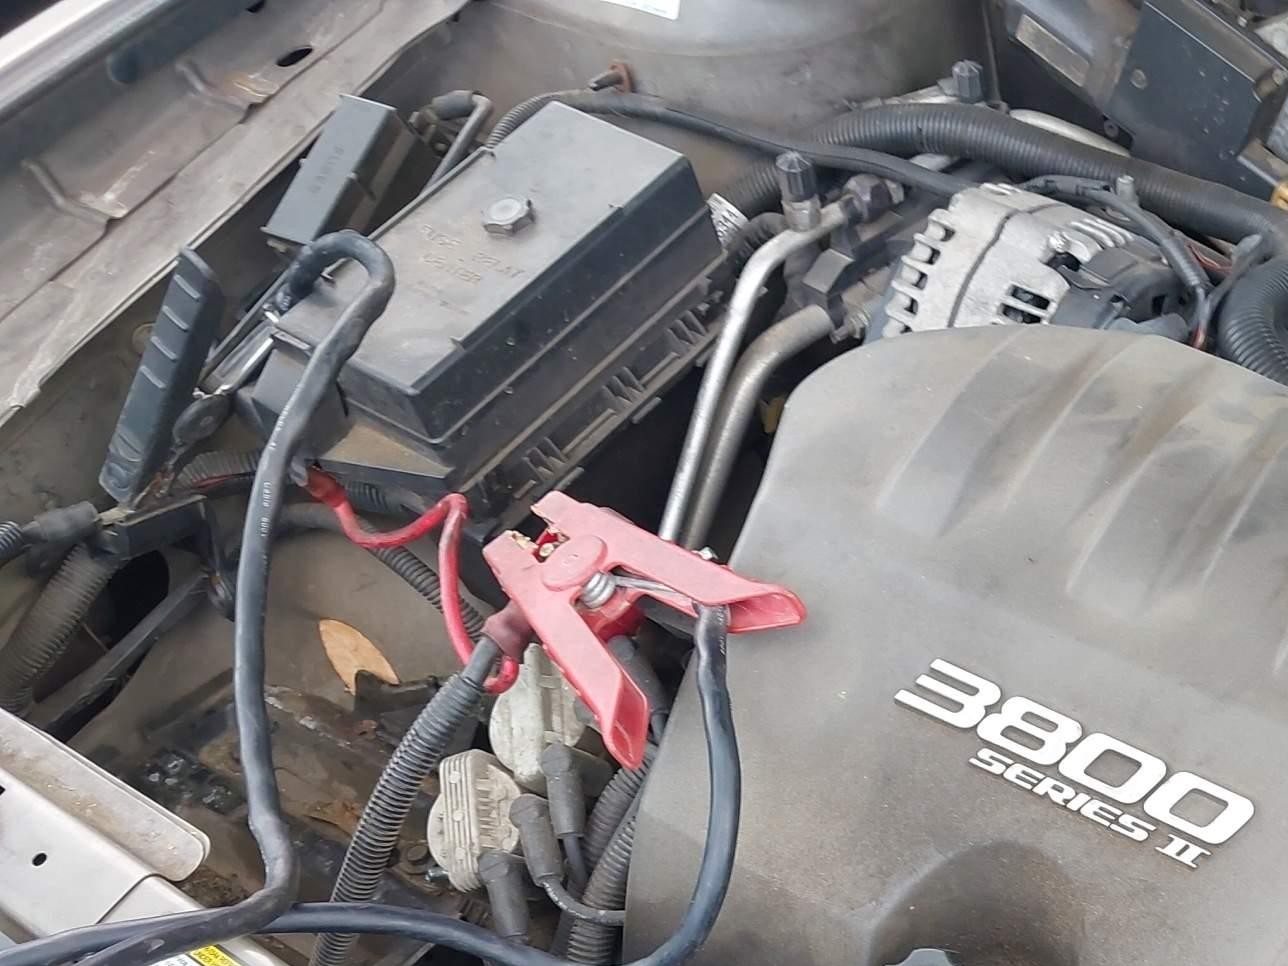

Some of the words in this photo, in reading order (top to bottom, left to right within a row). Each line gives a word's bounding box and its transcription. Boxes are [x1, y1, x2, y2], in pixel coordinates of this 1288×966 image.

[894, 658, 1255, 844] 3800
[968, 748, 1157, 842] SERIES
[1155, 833, 1211, 869] II
